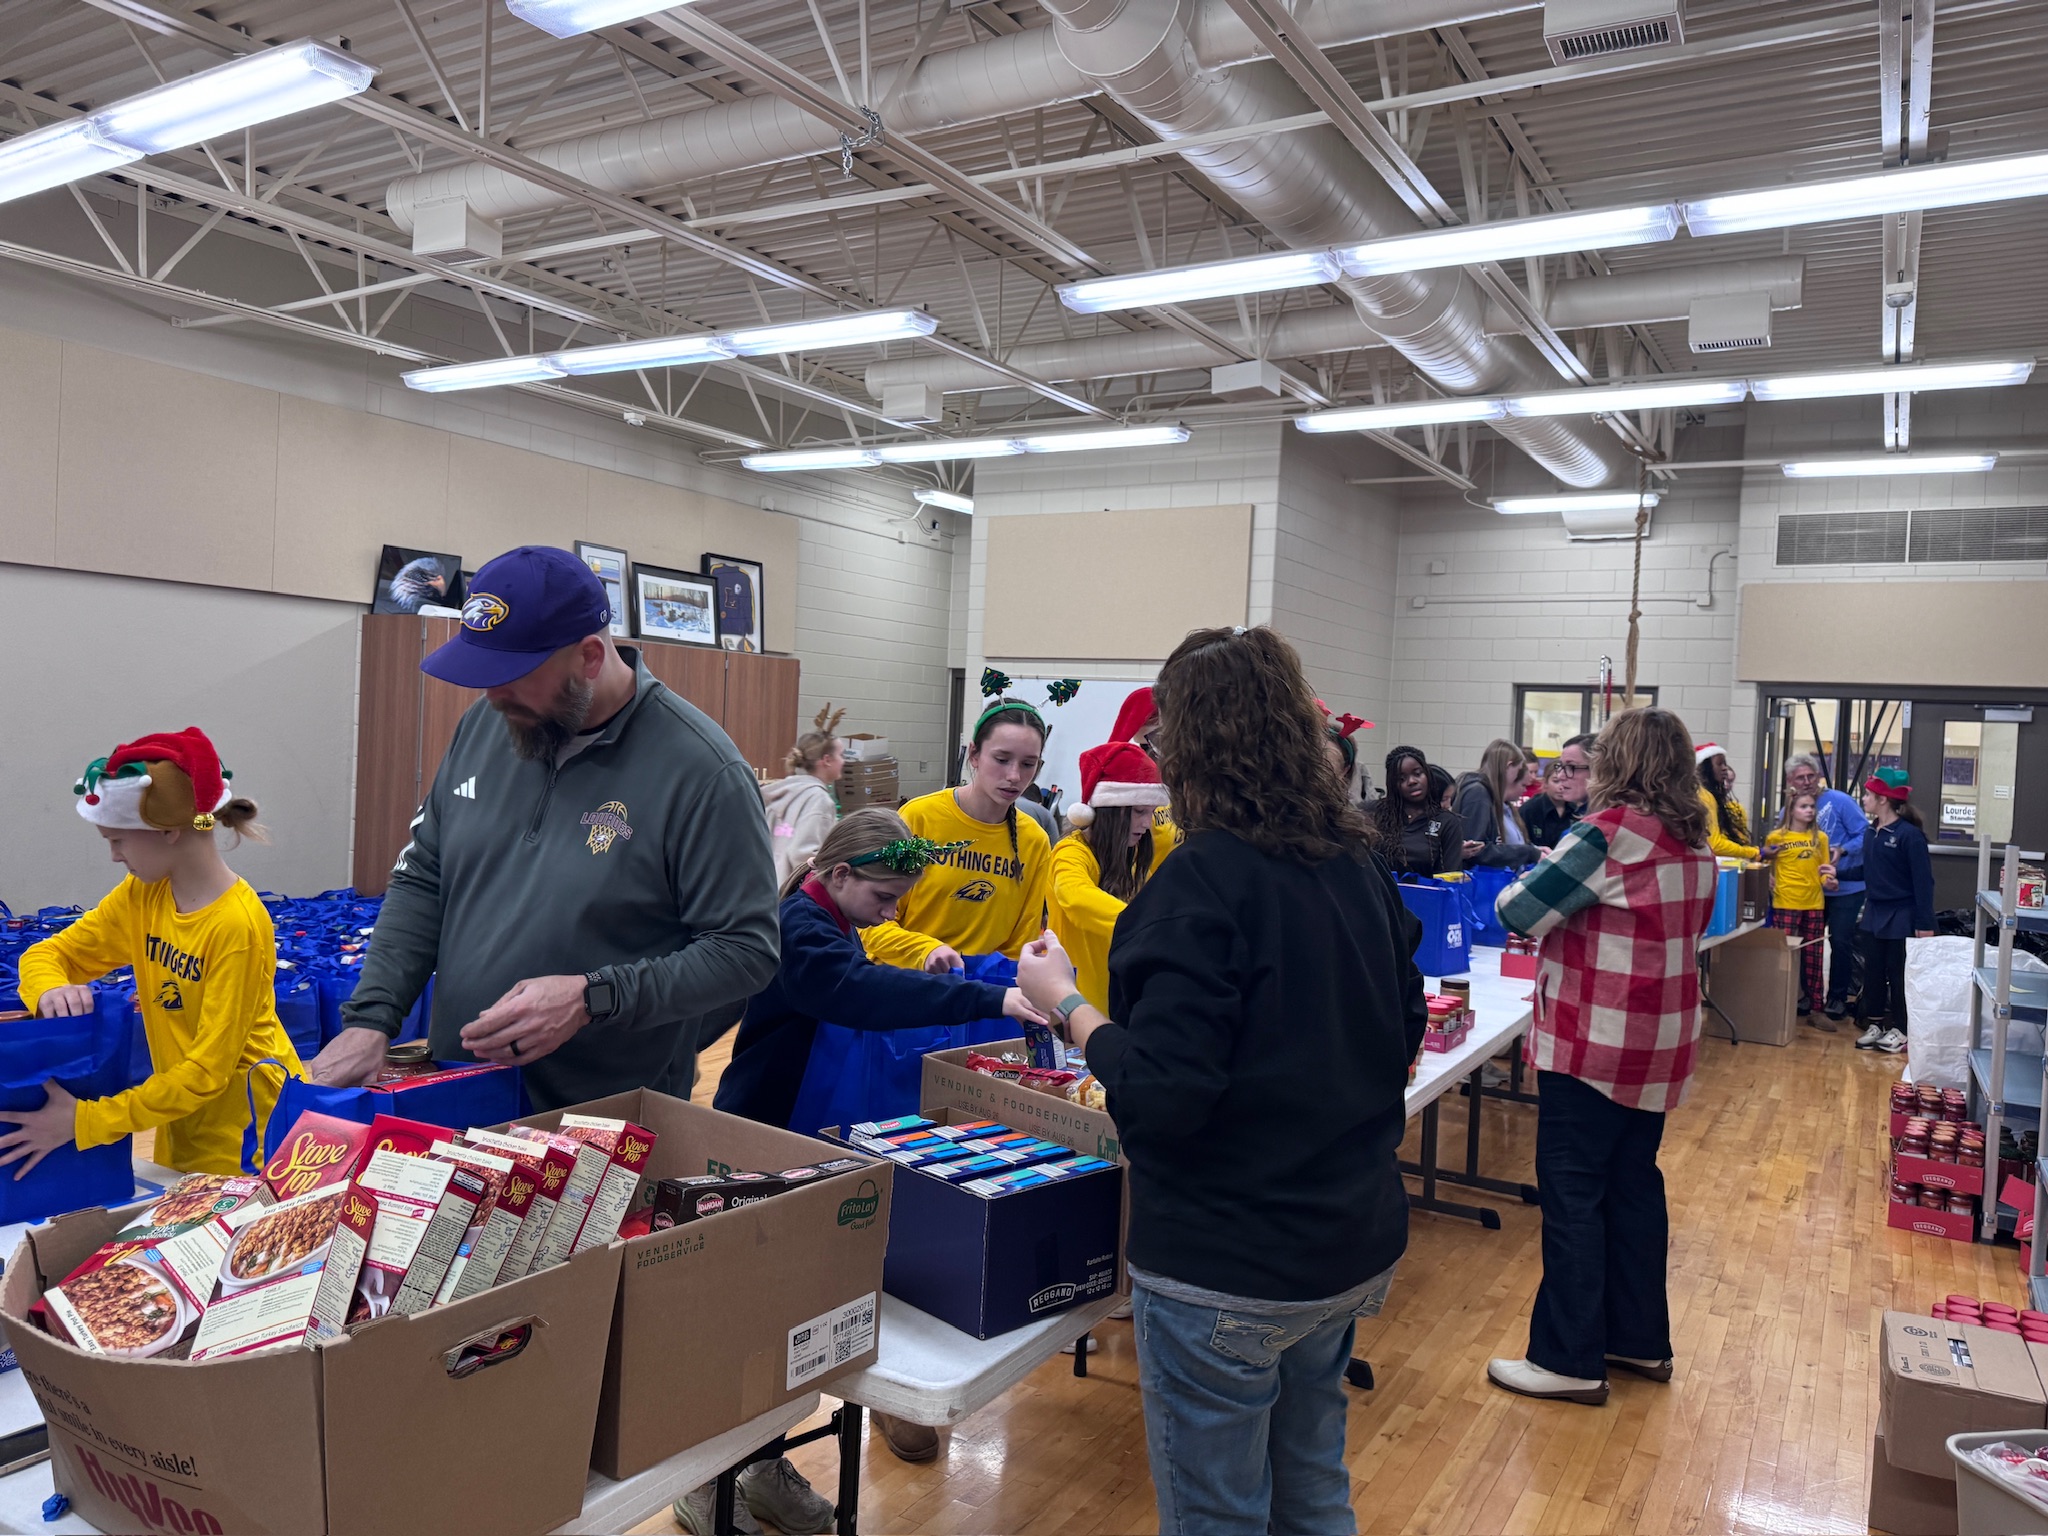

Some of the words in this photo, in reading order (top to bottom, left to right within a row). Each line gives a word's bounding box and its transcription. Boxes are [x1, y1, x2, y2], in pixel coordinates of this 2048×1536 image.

[1945, 806, 1976, 815] Lourdes
[580, 812, 633, 840] LOURDES
[926, 848, 991, 873] OTHING
[935, 1075, 983, 1098] VENDING
[989, 1093, 996, 1102] &
[1003, 1097, 1090, 1133] FOODSERVICE
[958, 1101, 970, 1110] USE
[970, 1104, 978, 1113] BY
[979, 1107, 992, 1118] AUG
[1029, 1123, 1040, 1134] USE
[1041, 1127, 1050, 1138] BY
[1052, 1130, 1066, 1143] AUG
[617, 1135, 649, 1155] Stove
[266, 1132, 347, 1180] Stove
[625, 1150, 641, 1163] Top
[277, 1167, 322, 1198] Top
[542, 1161, 568, 1183] Stove
[502, 1175, 535, 1198] Stove
[545, 1177, 560, 1189] Top
[278, 1202, 295, 1210] Turkey
[297, 1197, 307, 1205] Pot
[344, 1195, 372, 1217] Stove
[510, 1192, 526, 1206] Top
[351, 1213, 366, 1228] Top
[851, 1221, 865, 1230] Good
[637, 1237, 691, 1260] VENDING
[698, 1233, 704, 1241] &
[637, 1241, 705, 1270] FOODSERVICE
[1033, 1287, 1072, 1308] REGGANO
[75, 1324, 88, 1340] Turkey
[217, 1343, 237, 1353] Ultimate
[238, 1335, 260, 1346] Leftover
[260, 1330, 278, 1342] Turkey
[278, 1321, 305, 1335] Sandwich
[87, 1339, 98, 1351] Easy
[40, 1375, 81, 1409] there's
[80, 1401, 92, 1415] a
[59, 1408, 92, 1436] smile
[89, 1423, 107, 1445] in
[108, 1436, 148, 1467] every
[150, 1451, 199, 1477] aisle!
